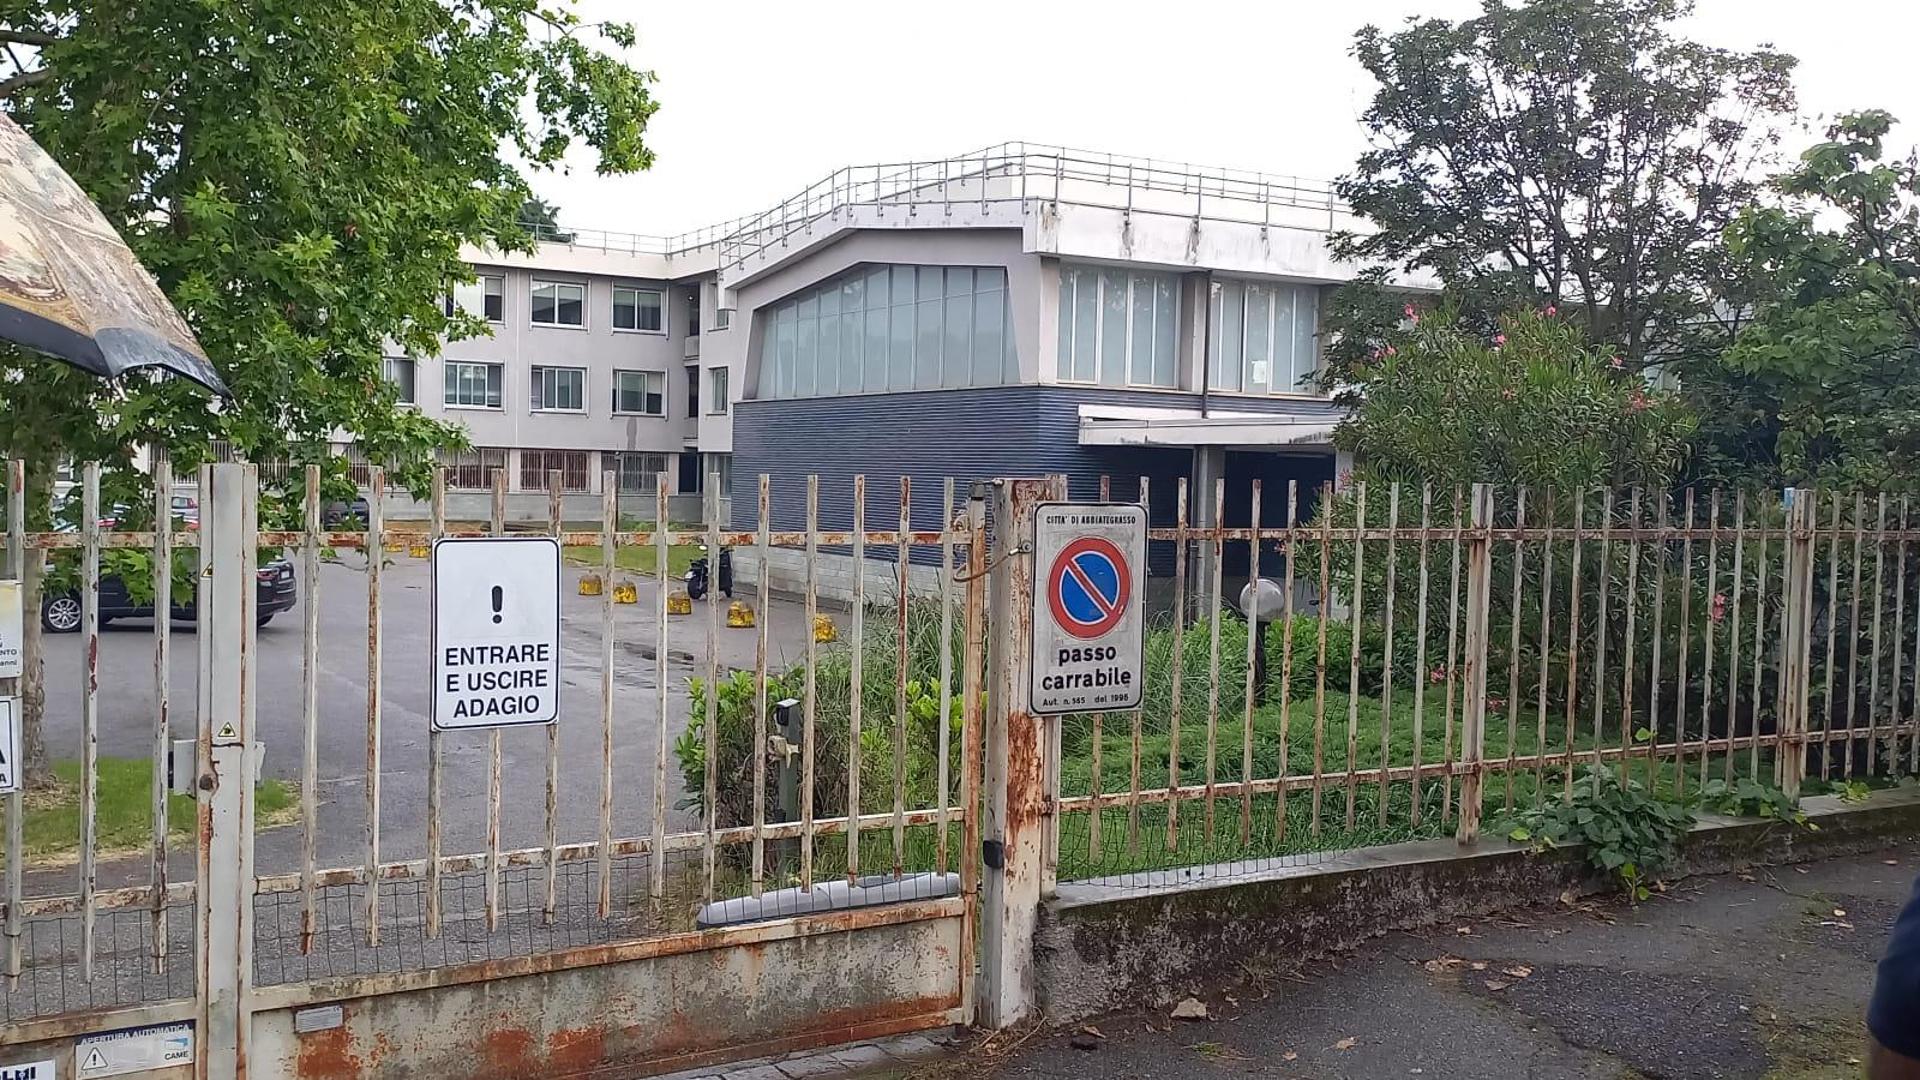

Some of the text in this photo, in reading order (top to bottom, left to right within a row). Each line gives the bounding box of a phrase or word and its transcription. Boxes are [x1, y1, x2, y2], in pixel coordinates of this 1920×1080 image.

[1071, 515, 1079, 524] DI
[1081, 515, 1136, 524] ABBIATEGRASSO
[445, 643, 550, 667] ENTRARE
[1058, 646, 1117, 667] passo
[446, 669, 548, 692] E USCIRE
[1042, 667, 1131, 691] carrabile
[453, 695, 540, 718] ADAGIO
[1094, 694, 1108, 703] del
[80, 1024, 190, 1046] APERTURA AUTOMATICA
[164, 1051, 189, 1061] CAME
[0, 1067, 36, 1080] LMI
